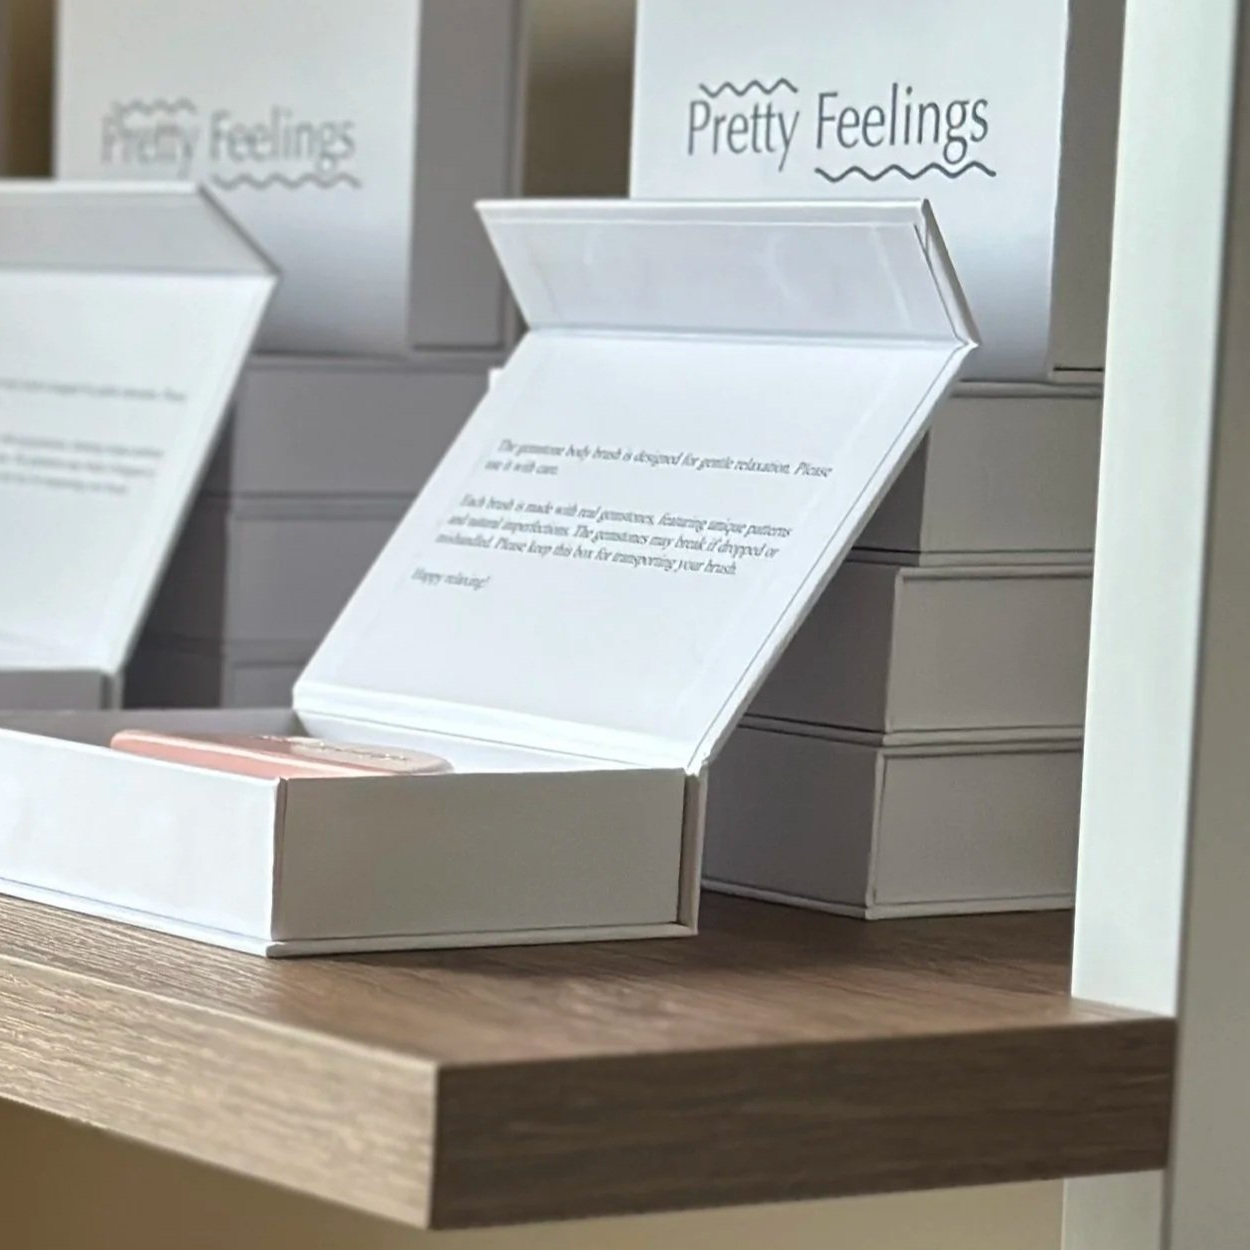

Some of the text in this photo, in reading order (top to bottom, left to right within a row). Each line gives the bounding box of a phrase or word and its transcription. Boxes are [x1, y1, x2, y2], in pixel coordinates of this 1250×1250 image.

[209, 103, 356, 175] Feelings
[687, 82, 989, 172] Pretty Feelings
[500, 439, 516, 452] The
[566, 444, 590, 461] body
[592, 445, 621, 460] brush
[622, 449, 633, 461] is
[633, 450, 683, 467] designed
[681, 452, 699, 467] for
[697, 456, 734, 471] gentle
[734, 457, 791, 475] relaxation.
[794, 461, 833, 478] Please
[513, 460, 535, 473] with
[448, 512, 469, 525] and
[467, 516, 503, 530] natural
[573, 524, 593, 538] The
[590, 529, 647, 544] gemstones
[649, 535, 674, 550] may
[674, 535, 707, 551] break
[706, 537, 723, 553] if
[718, 541, 766, 559] dropped
[764, 547, 780, 558] or
[461, 493, 792, 539] Each brush is made with real gemstones, featuring unique patterns
[411, 567, 446, 586] Happy
[493, 537, 527, 553] Please
[526, 540, 552, 557] keep
[552, 542, 573, 557] this
[572, 545, 593, 560] box
[593, 546, 612, 562] for
[612, 551, 677, 571] transporting
[674, 558, 704, 572] your
[703, 559, 737, 575] brush.
